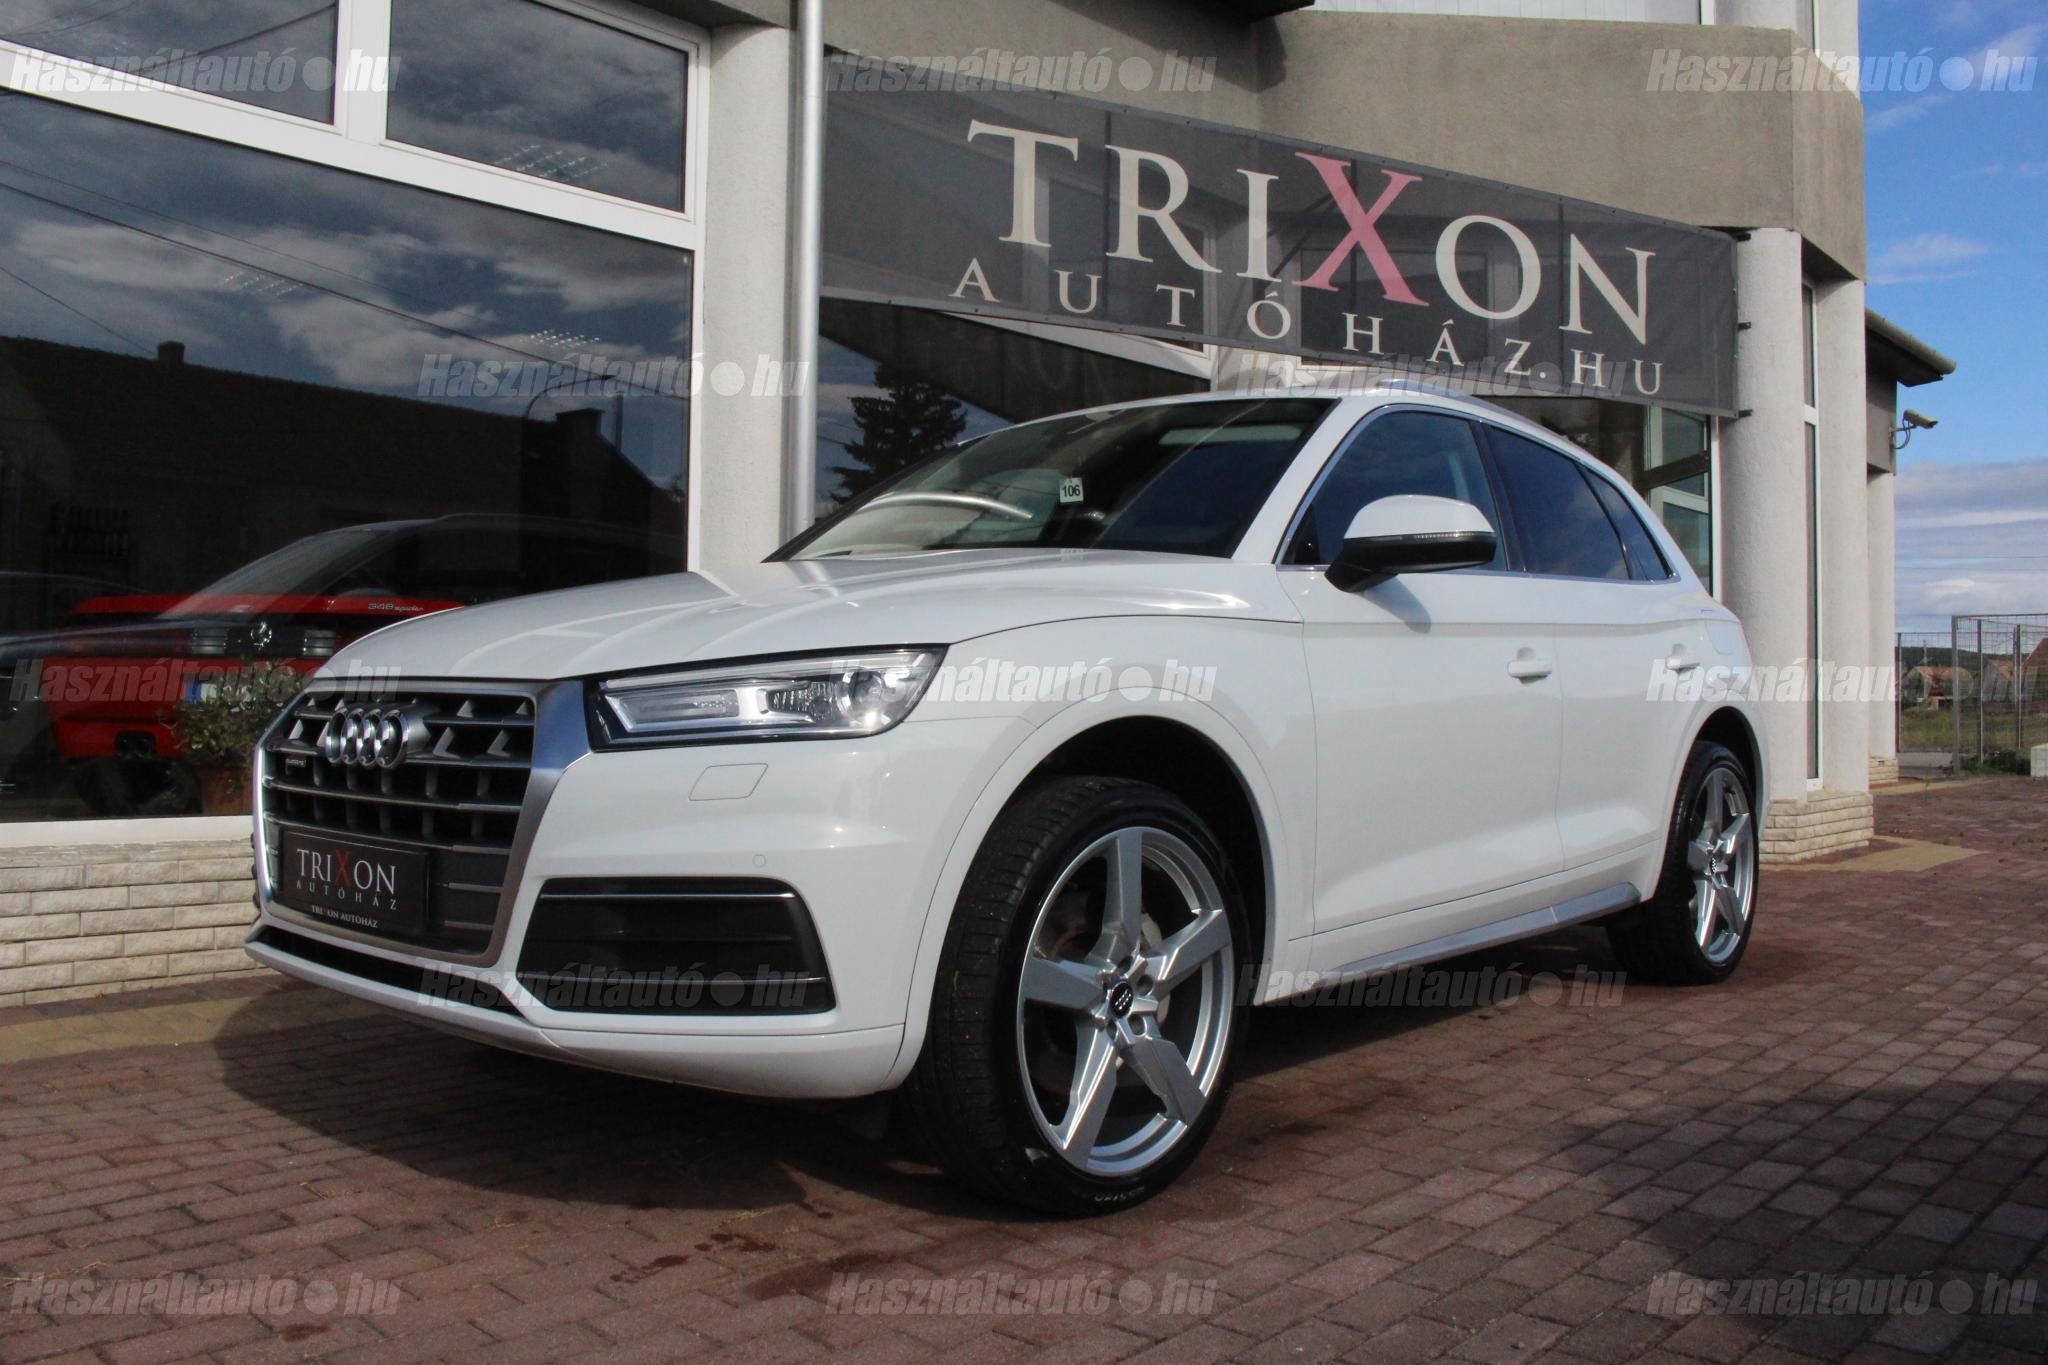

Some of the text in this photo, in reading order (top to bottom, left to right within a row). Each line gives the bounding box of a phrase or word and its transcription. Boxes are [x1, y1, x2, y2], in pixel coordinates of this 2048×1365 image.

[967, 119, 1656, 345] TRIXON
[948, 257, 1663, 396] AUTÓHÁZ.HU
[1062, 484, 1081, 497] 106
[296, 848, 396, 895] TRIXON
[296, 879, 397, 911] AUTÓHÁZ
[311, 905, 339, 919] TRION
